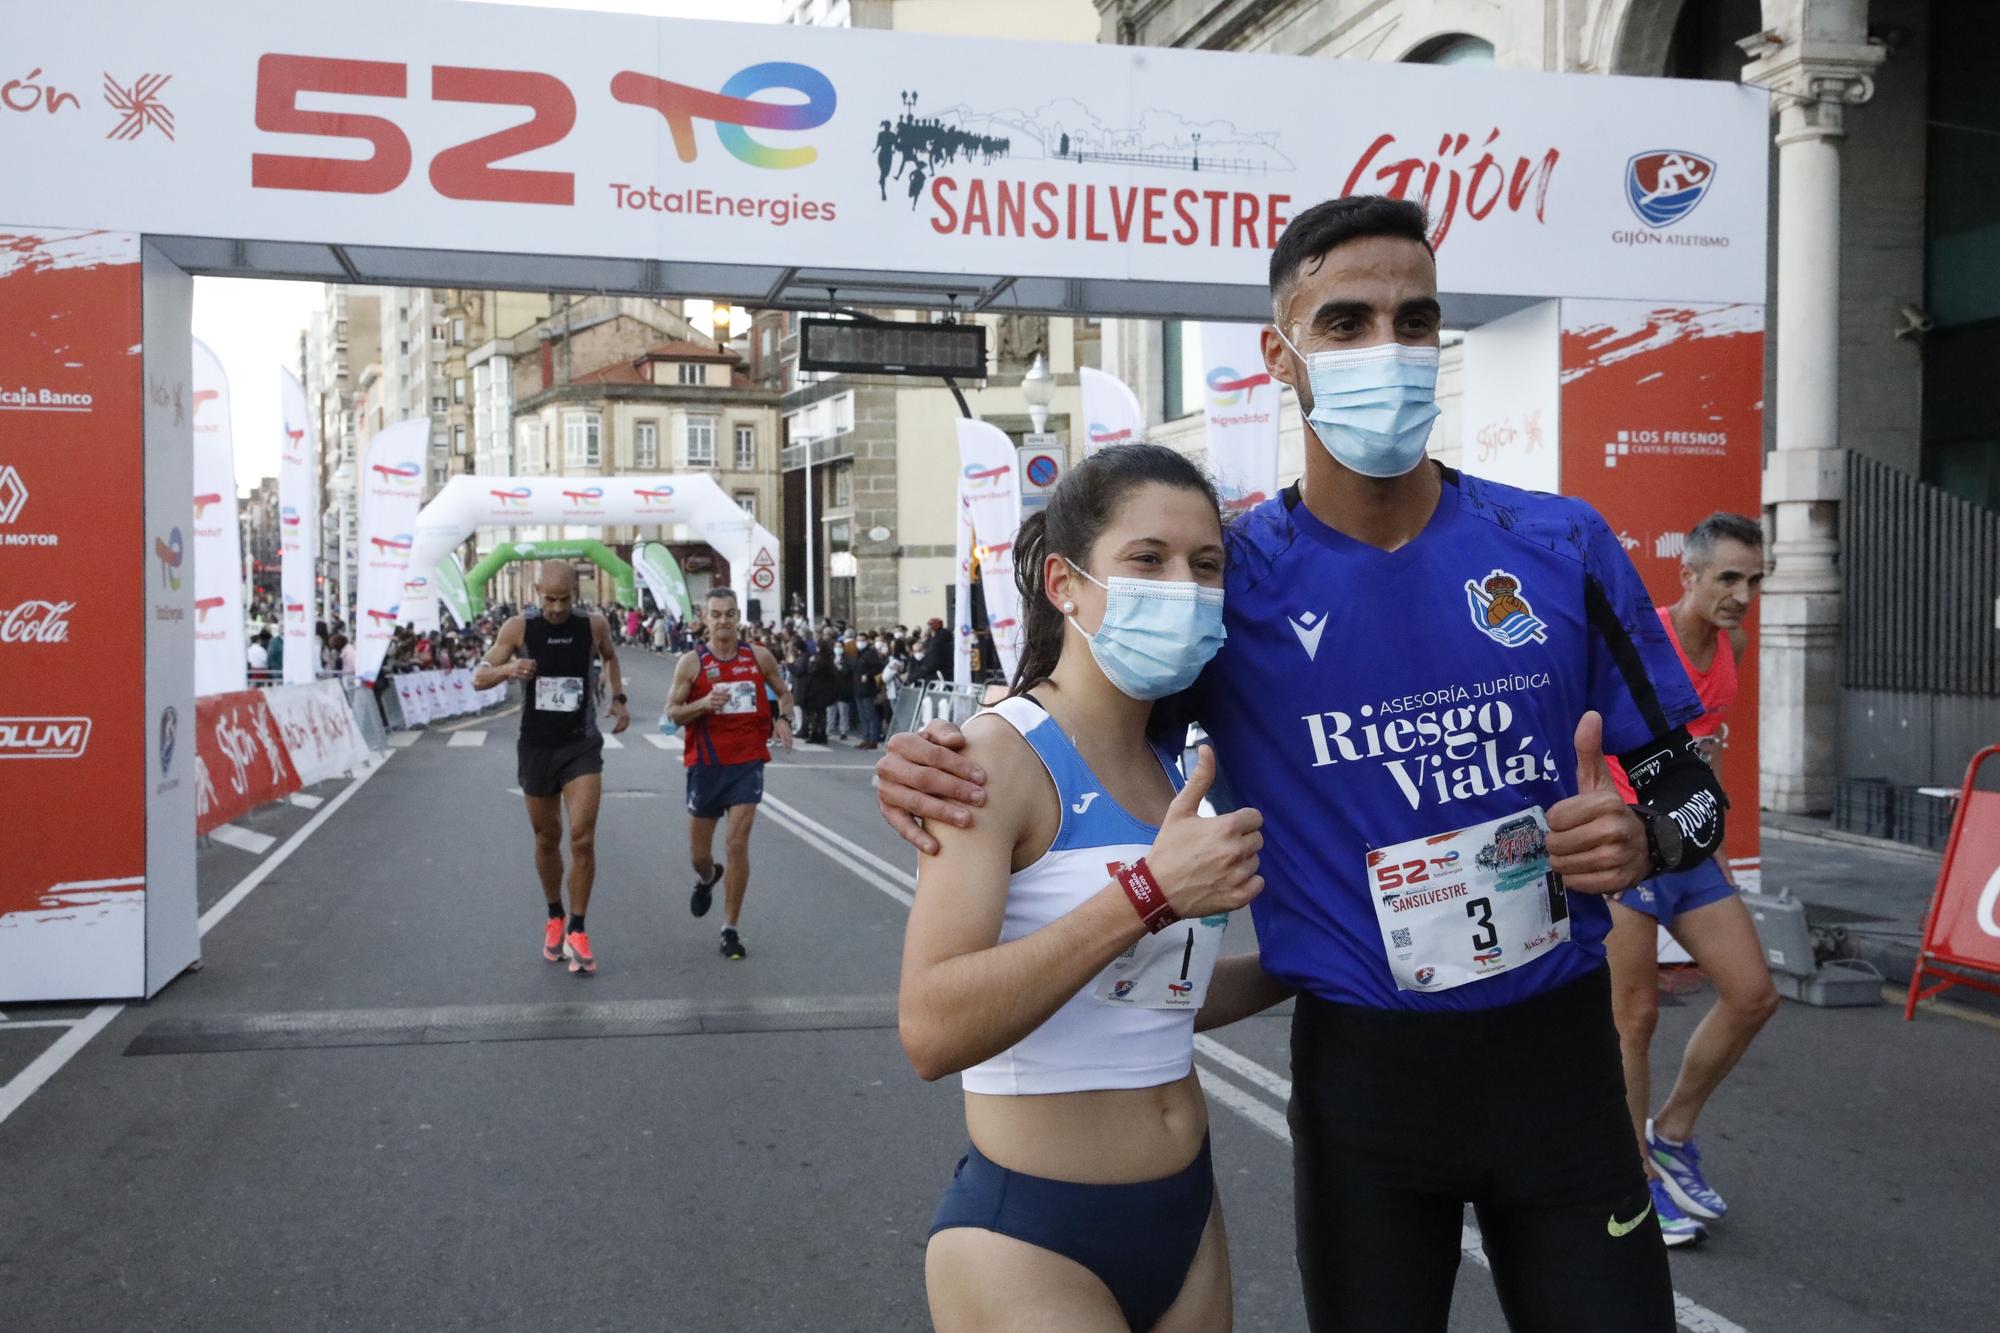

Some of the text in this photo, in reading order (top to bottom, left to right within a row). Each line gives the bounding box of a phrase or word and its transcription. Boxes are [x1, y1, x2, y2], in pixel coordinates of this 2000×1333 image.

[251, 52, 577, 206] 52
[609, 182, 837, 226] TotalEnergies
[1340, 126, 1560, 253] Gijón
[930, 175, 1291, 249] SANSILVESTRE
[1611, 228, 1730, 248] GIJÓN ATLETISMO
[39, 389, 93, 405] Banco
[1631, 431, 1728, 446] LOS FRESNOS
[1631, 444, 1727, 456] CENTRO COMERCIAL
[5, 534, 59, 545] MOTOR
[552, 693, 565, 704] 44
[1380, 672, 1551, 716] ASESORÍA JURÍDICA
[1301, 700, 1513, 767] Riesgo
[1128, 879, 1144, 901] JUNTOS
[1131, 872, 1151, 903] LLEGAMOS
[1139, 874, 1152, 894] LEJOS
[1376, 859, 1430, 891] 52
[1392, 882, 1469, 913] SANSILVESTRE
[1466, 897, 1498, 951] 3
